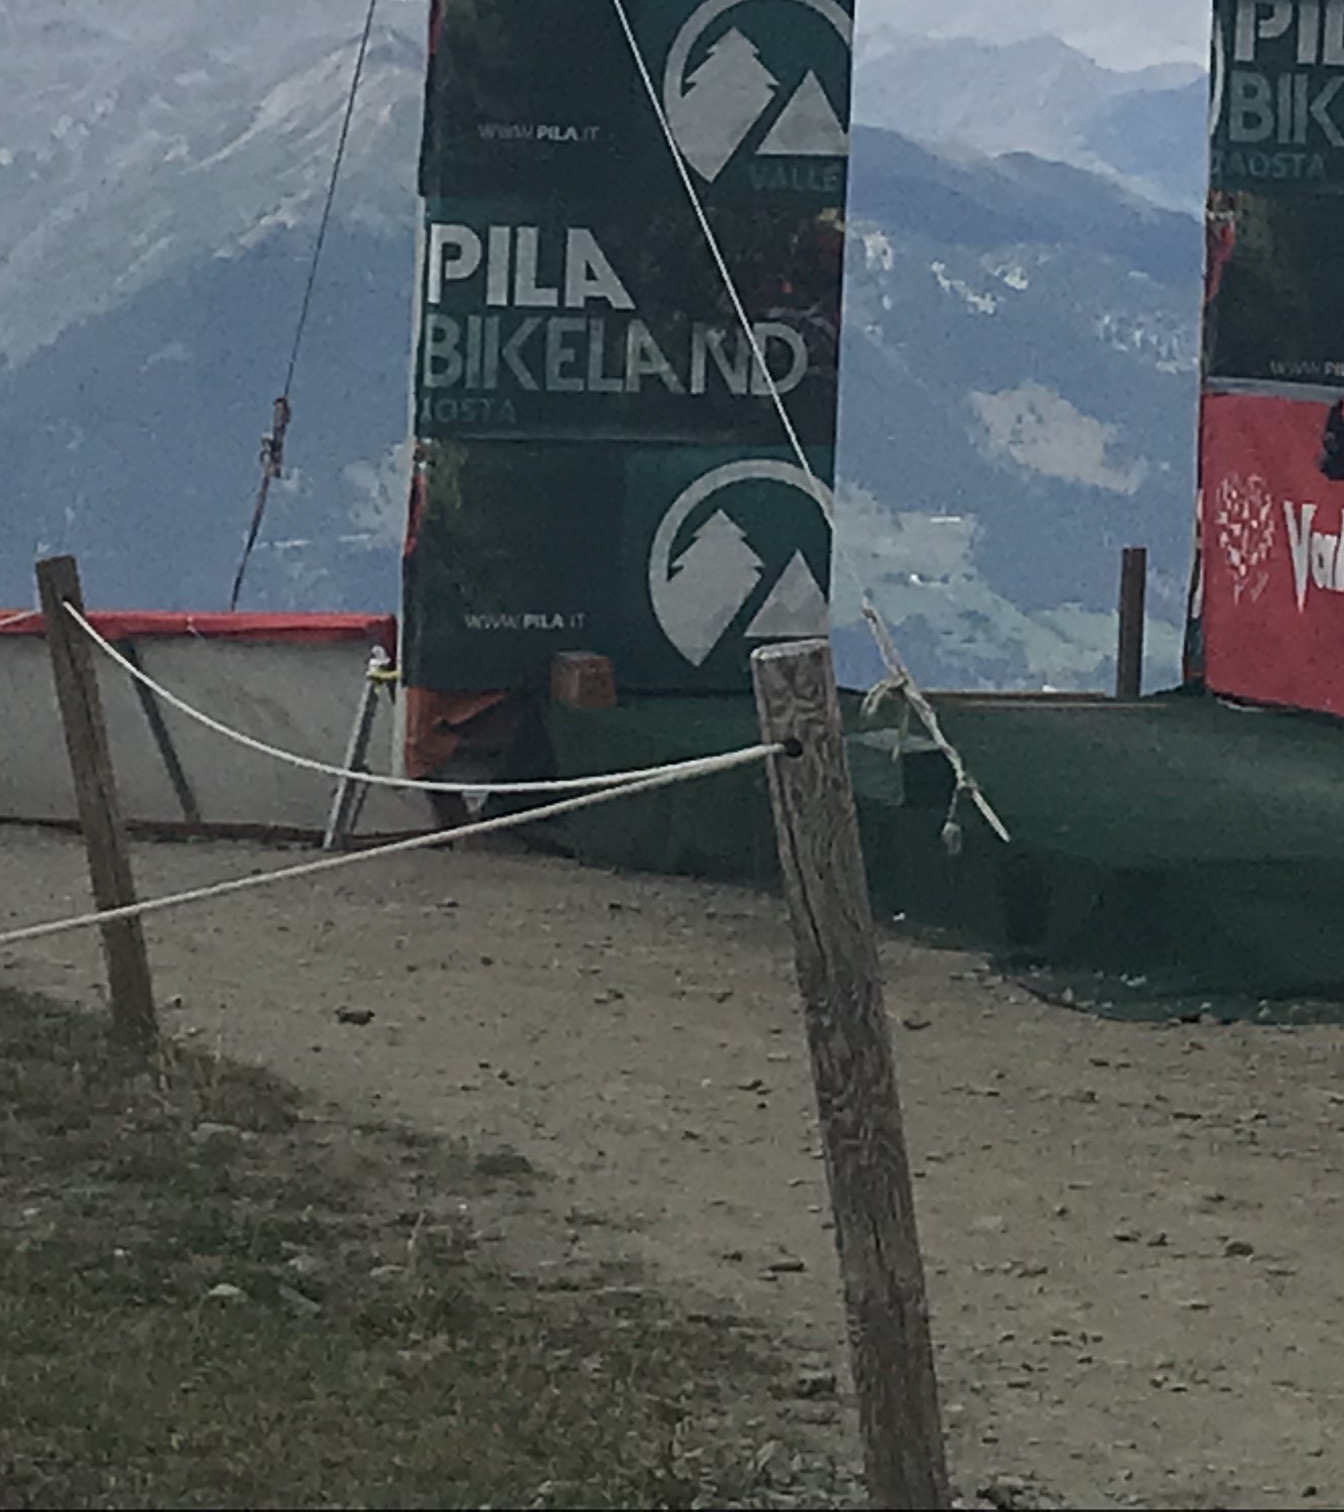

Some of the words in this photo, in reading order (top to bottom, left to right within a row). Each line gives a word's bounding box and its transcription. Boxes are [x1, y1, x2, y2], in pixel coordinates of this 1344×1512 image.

[477, 123, 601, 142] WWW.PILA.IT
[426, 222, 636, 311] PILA
[421, 311, 809, 396] BIKELAND
[463, 613, 587, 630] WWW.PILA.IT
